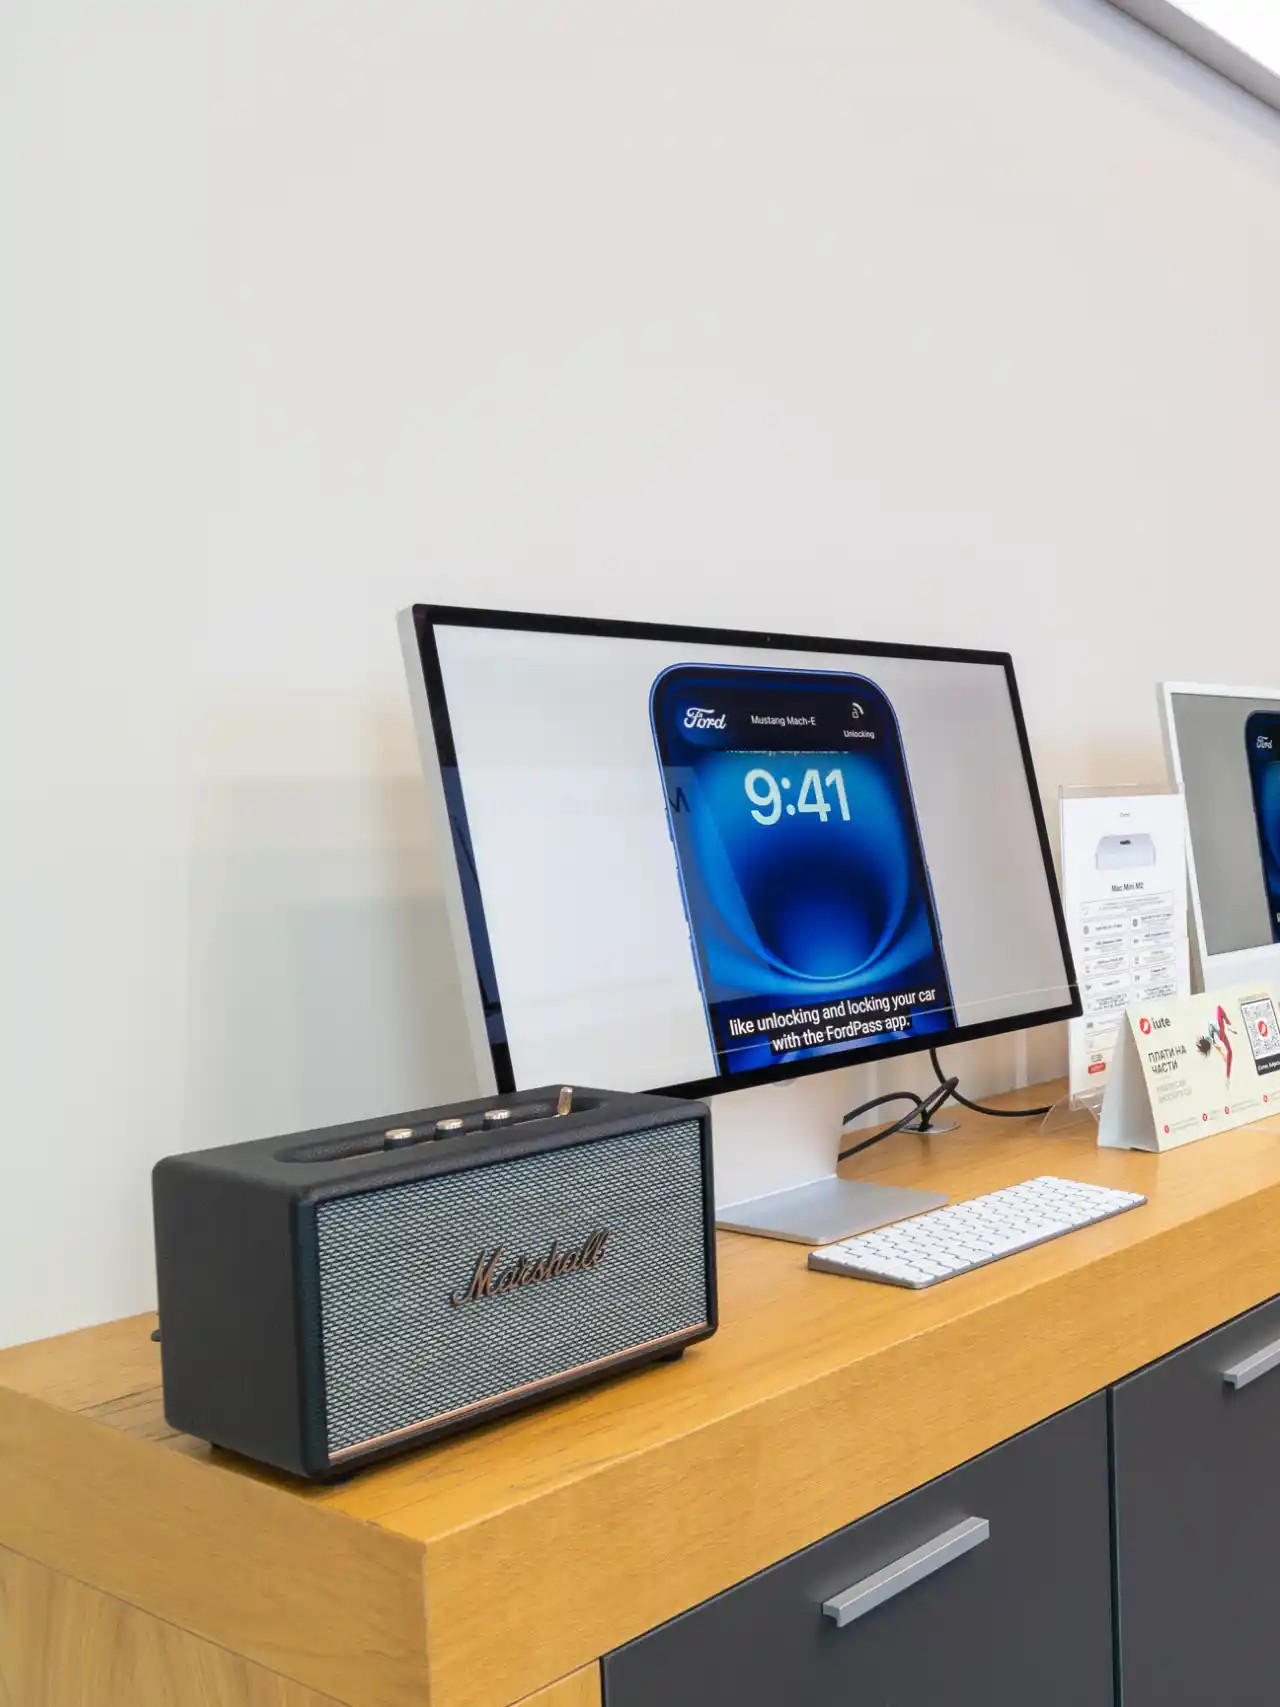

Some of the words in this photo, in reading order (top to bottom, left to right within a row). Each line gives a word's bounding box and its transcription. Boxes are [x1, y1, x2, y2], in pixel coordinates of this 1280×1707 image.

[684, 707, 727, 729] Ford
[751, 715, 786, 726] Mustang
[787, 716, 816, 726] Mach-E
[843, 730, 875, 739] Unlocking
[744, 768, 850, 826] 9:41
[729, 1019, 755, 1036] like
[757, 1008, 820, 1031] unlocking
[822, 1001, 845, 1019] and
[847, 995, 890, 1015] locking
[891, 992, 916, 1009] your
[918, 988, 936, 1002] car
[771, 1033, 801, 1051] with
[803, 1029, 824, 1045] the
[827, 1018, 882, 1041] FordPass
[885, 1015, 911, 1032] app.
[1151, 1017, 1171, 1030] iute
[1148, 1047, 1175, 1063] ПЛАТИ
[1175, 1044, 1187, 1057] НА
[1151, 1059, 1178, 1074] ЧАСТИ
[451, 1228, 609, 1305] Marshall
